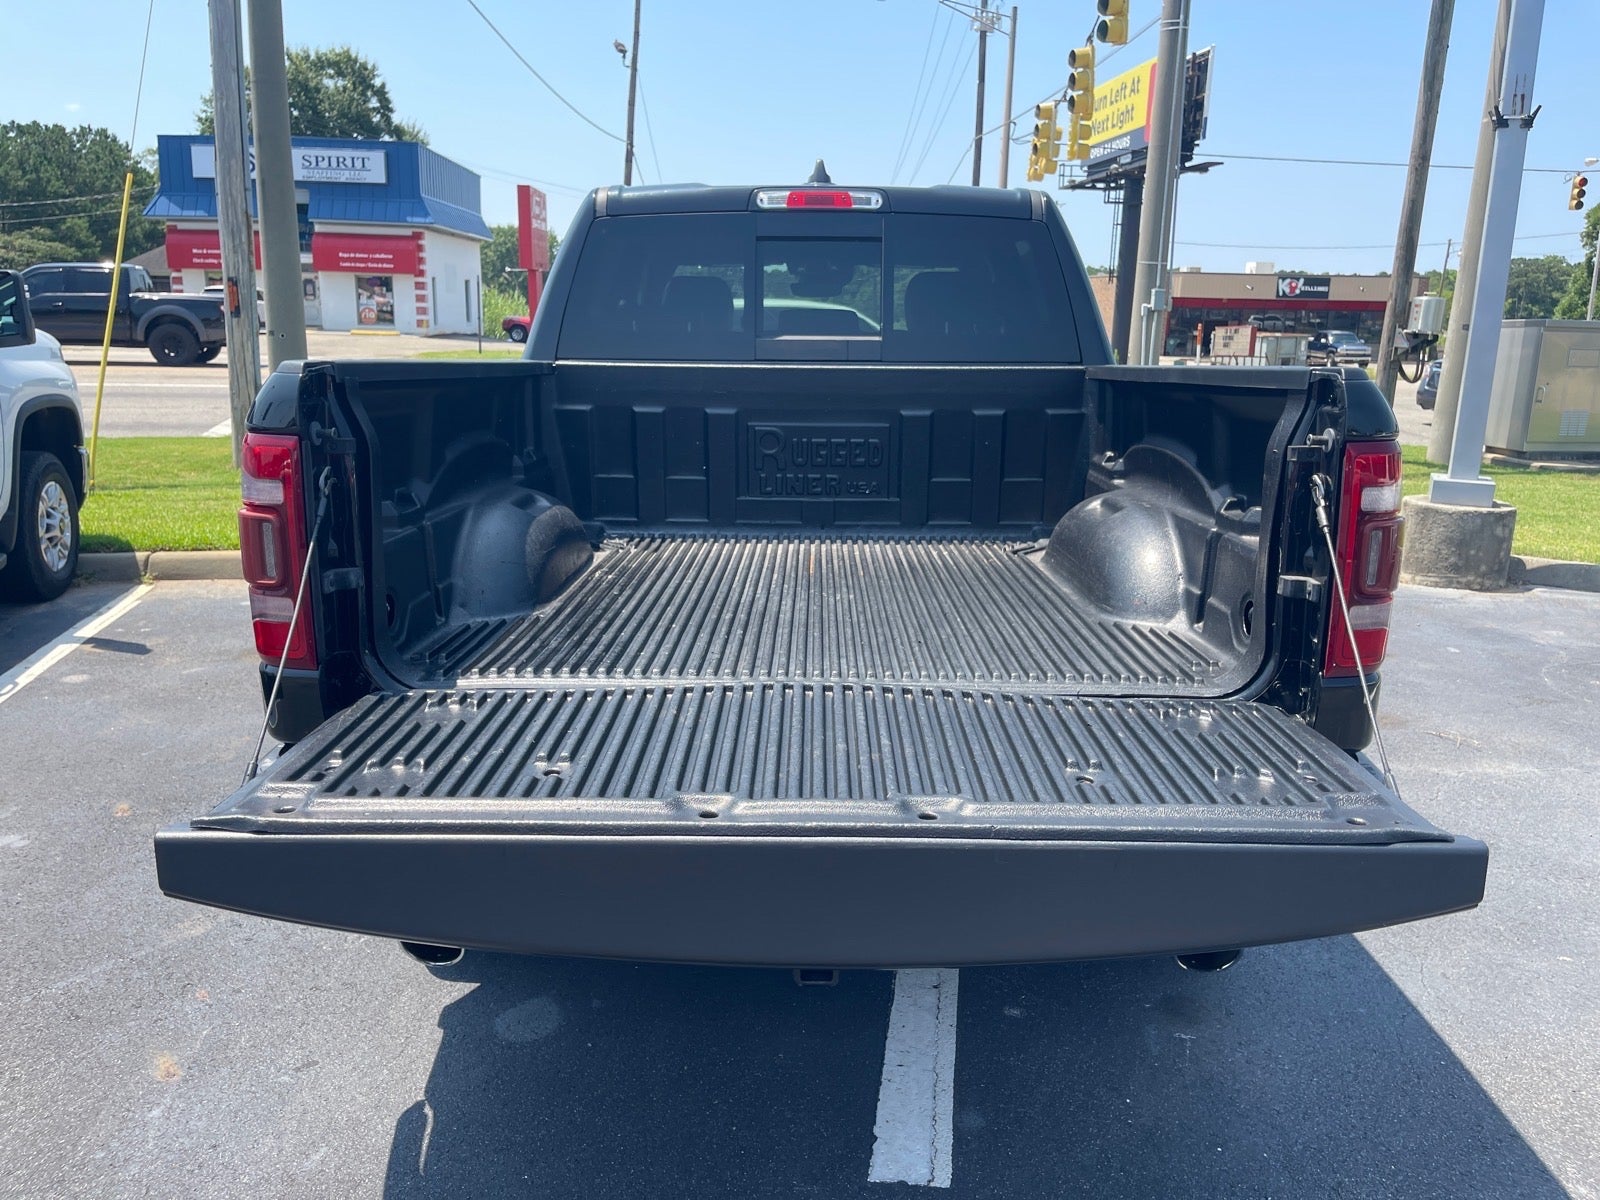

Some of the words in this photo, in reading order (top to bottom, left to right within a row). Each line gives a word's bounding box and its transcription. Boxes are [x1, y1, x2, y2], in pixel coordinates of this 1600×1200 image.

[1094, 95, 1107, 112] urn
[1110, 81, 1127, 106] Left
[1129, 75, 1140, 97] At
[1092, 114, 1109, 136] Next
[1111, 103, 1134, 130] Light
[301, 153, 371, 169] SPIRIT
[1090, 147, 1103, 159] OPEN
[1112, 135, 1130, 152] HOURS
[754, 426, 883, 471] RUGGED
[759, 473, 841, 496] LINER
[847, 481, 880, 495] USA
